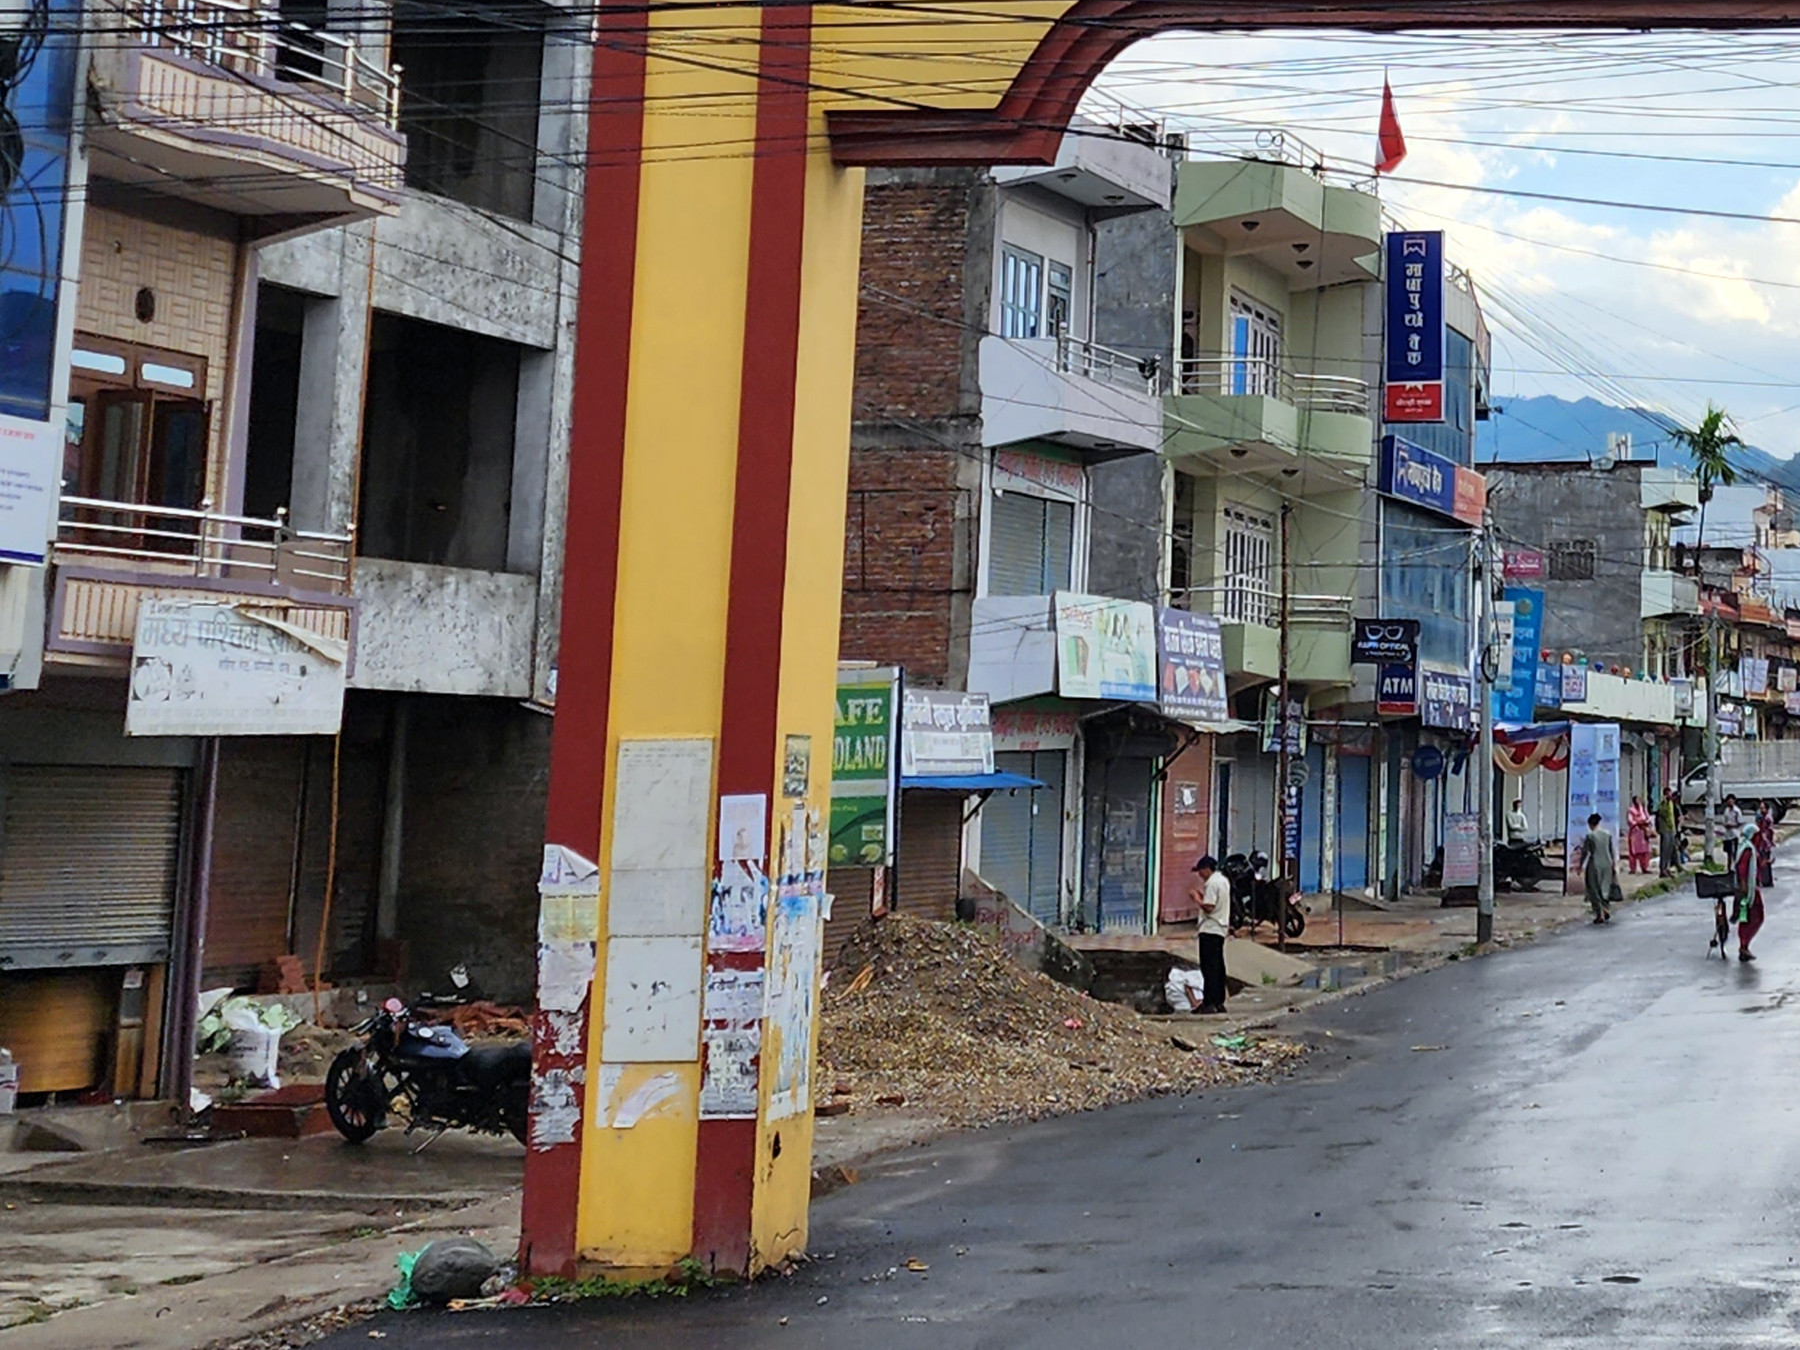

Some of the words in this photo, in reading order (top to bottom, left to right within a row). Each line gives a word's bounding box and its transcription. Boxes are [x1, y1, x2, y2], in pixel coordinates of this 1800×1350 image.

[1382, 677, 1413, 694] ATM
[834, 698, 884, 727] AFE
[833, 735, 886, 771] DLAND
